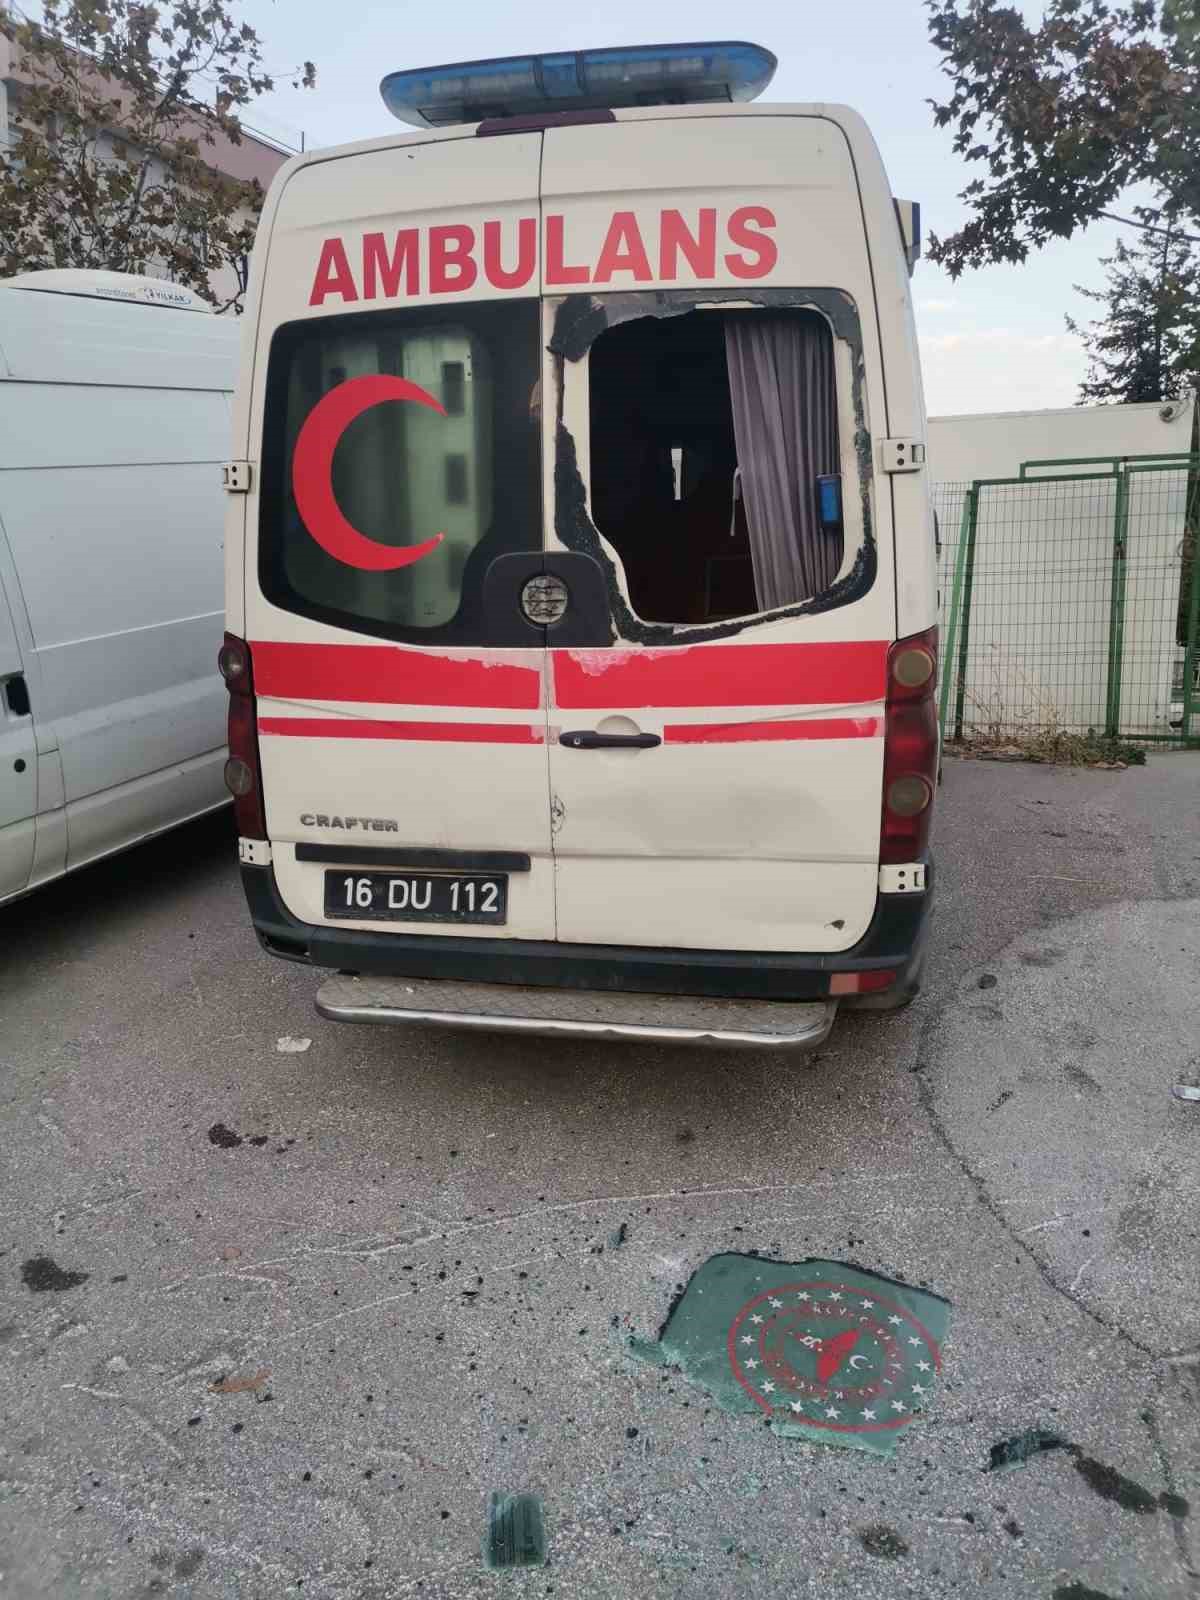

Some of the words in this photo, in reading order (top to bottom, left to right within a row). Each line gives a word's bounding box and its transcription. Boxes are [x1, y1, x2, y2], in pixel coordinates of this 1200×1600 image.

[309, 206, 778, 305] AMBULANS
[300, 813, 399, 832] CRAFTER
[344, 877, 373, 907] 16
[388, 879, 432, 910] DU
[450, 882, 498, 912] 112
